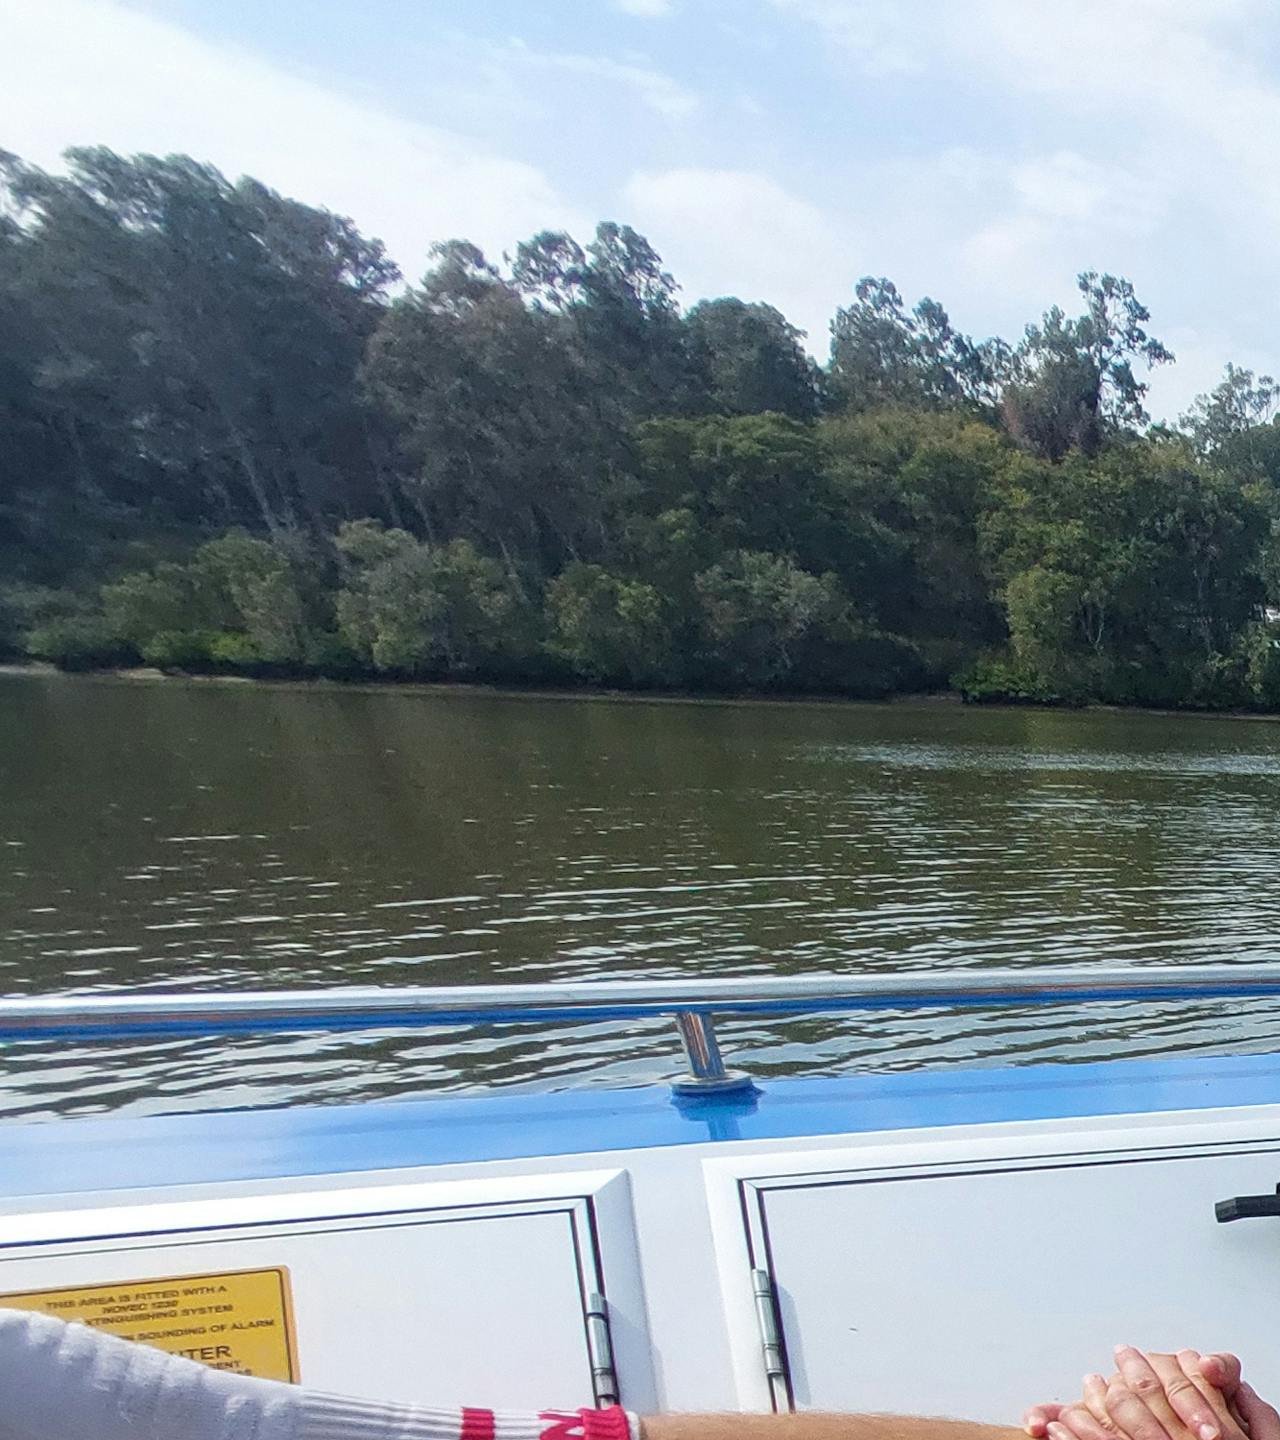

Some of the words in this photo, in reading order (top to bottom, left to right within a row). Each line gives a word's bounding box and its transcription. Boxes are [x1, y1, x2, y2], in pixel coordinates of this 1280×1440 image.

[79, 1296, 116, 1306] AREA
[182, 1287, 215, 1296] WITH
[217, 1285, 228, 1293] A
[181, 1304, 234, 1316] SYSTEM
[137, 1326, 207, 1340] SOUNDING
[210, 1324, 227, 1333] OF
[230, 1319, 274, 1330] ALARM
